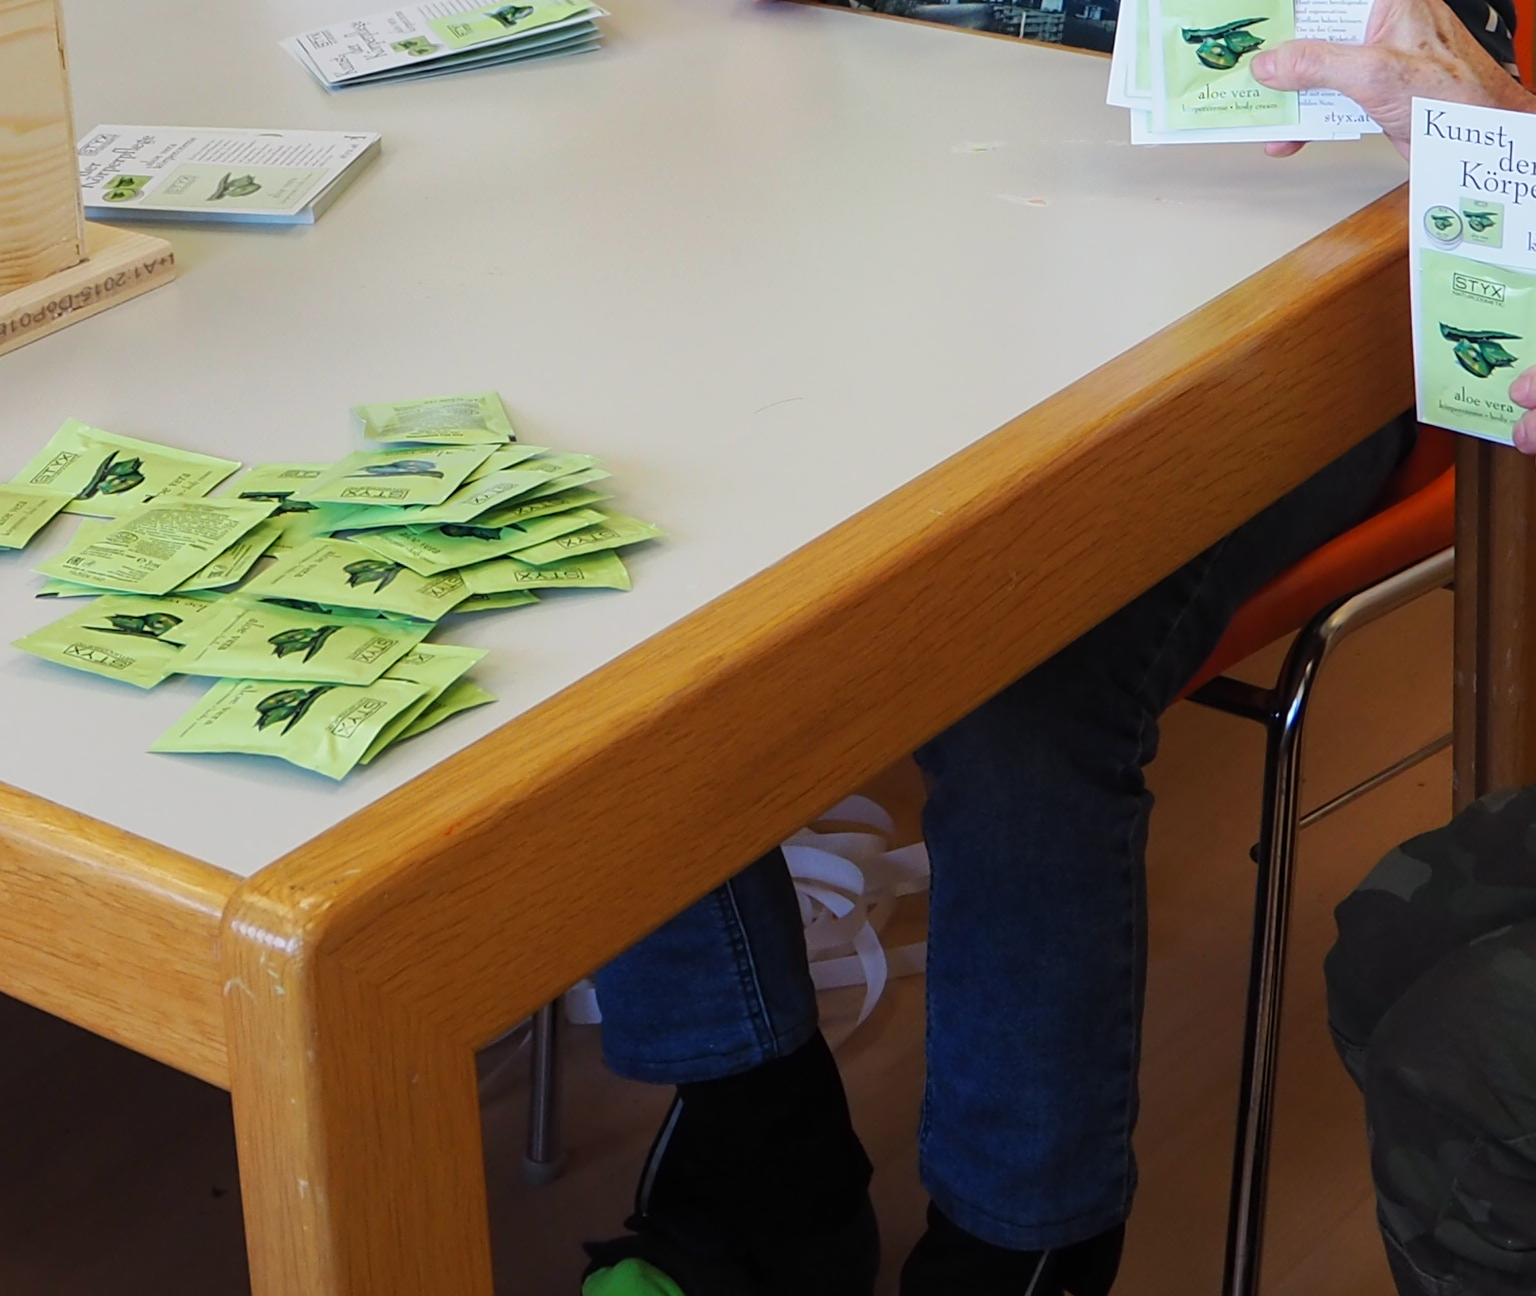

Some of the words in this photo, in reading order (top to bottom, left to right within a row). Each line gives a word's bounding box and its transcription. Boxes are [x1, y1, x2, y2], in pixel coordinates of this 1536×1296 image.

[1198, 83, 1227, 101] aloe
[1231, 89, 1261, 99] vera
[1324, 111, 1371, 126] styx.at
[1423, 108, 1508, 149] Kunst
[81, 134, 157, 190] Körperpflege
[1455, 276, 1504, 301] STYX
[1453, 386, 1482, 407] aloe
[1484, 399, 1515, 414] vera
[34, 451, 76, 483] STYX
[343, 487, 408, 500] STYX
[66, 643, 128, 669] STYX
[363, 637, 397, 664] STYX
[333, 698, 386, 738] STYX
